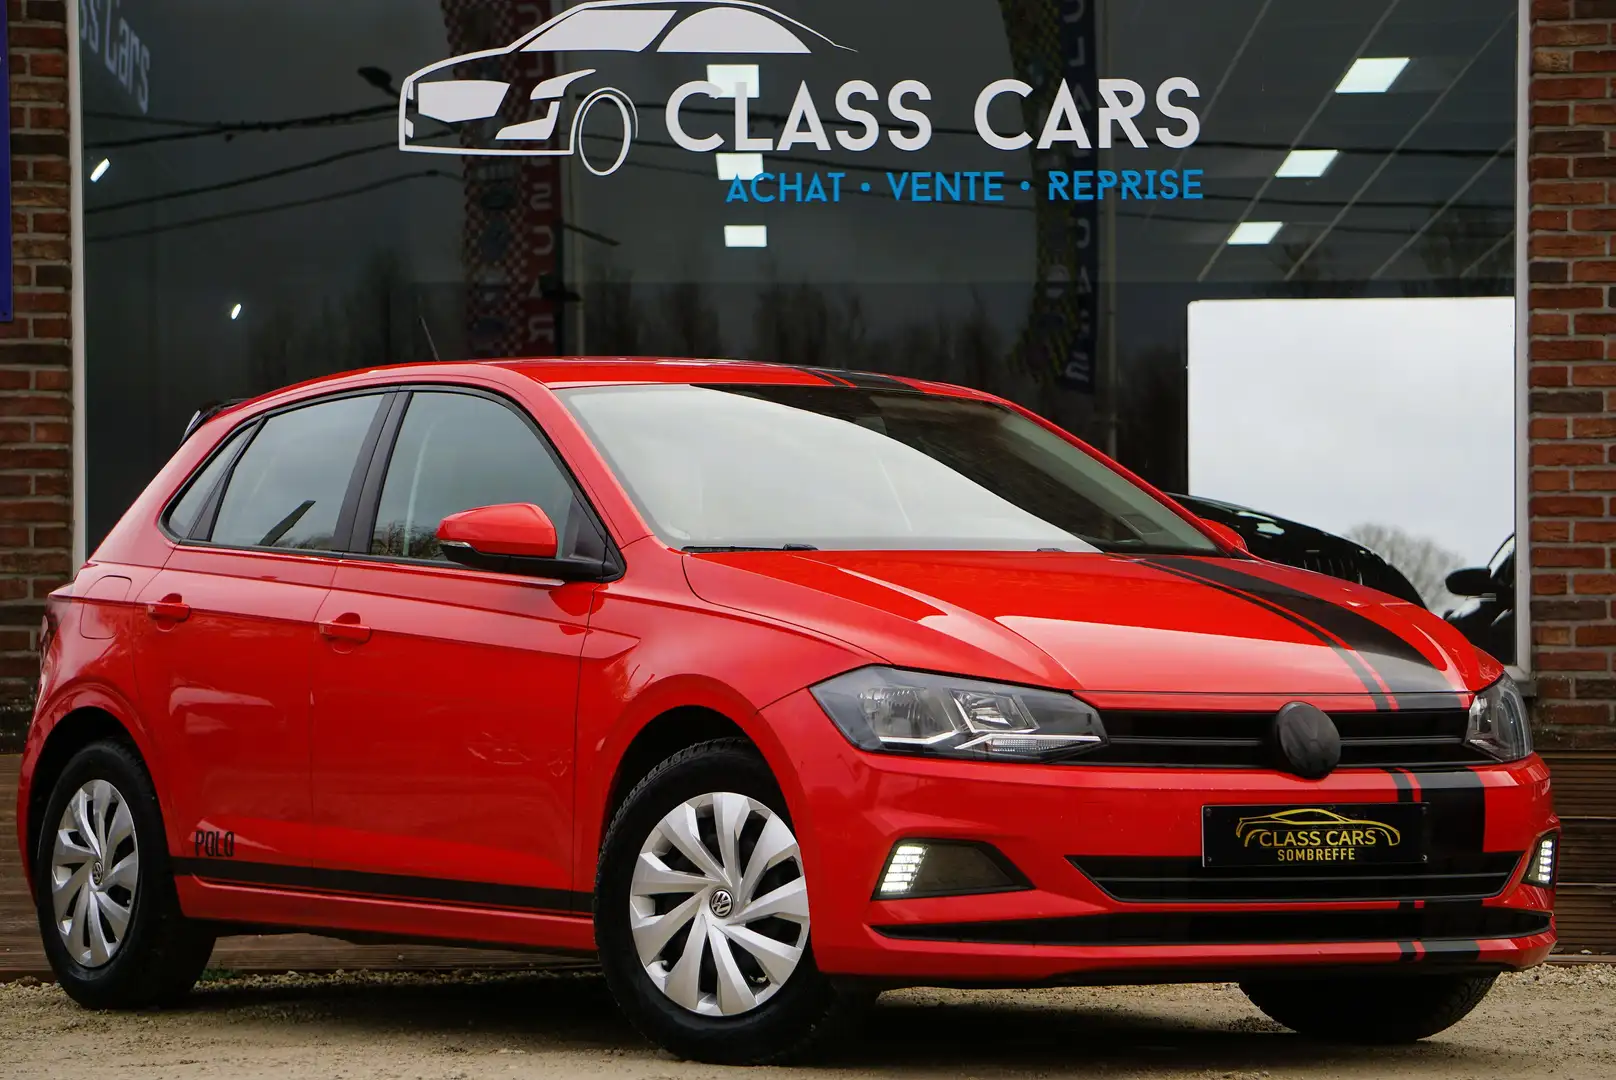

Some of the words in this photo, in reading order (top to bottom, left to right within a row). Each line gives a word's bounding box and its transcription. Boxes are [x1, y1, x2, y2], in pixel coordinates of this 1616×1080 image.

[665, 80, 932, 152] CLASS
[974, 77, 1200, 151] CARS
[725, 172, 846, 203] ACHAT
[886, 171, 1004, 202] VENTE
[1048, 169, 1204, 201] REPRISE
[195, 830, 235, 857] POLO
[1258, 830, 1321, 847] CLASS
[1325, 829, 1377, 846] CARS
[1277, 847, 1356, 862] SOMBREFFE
